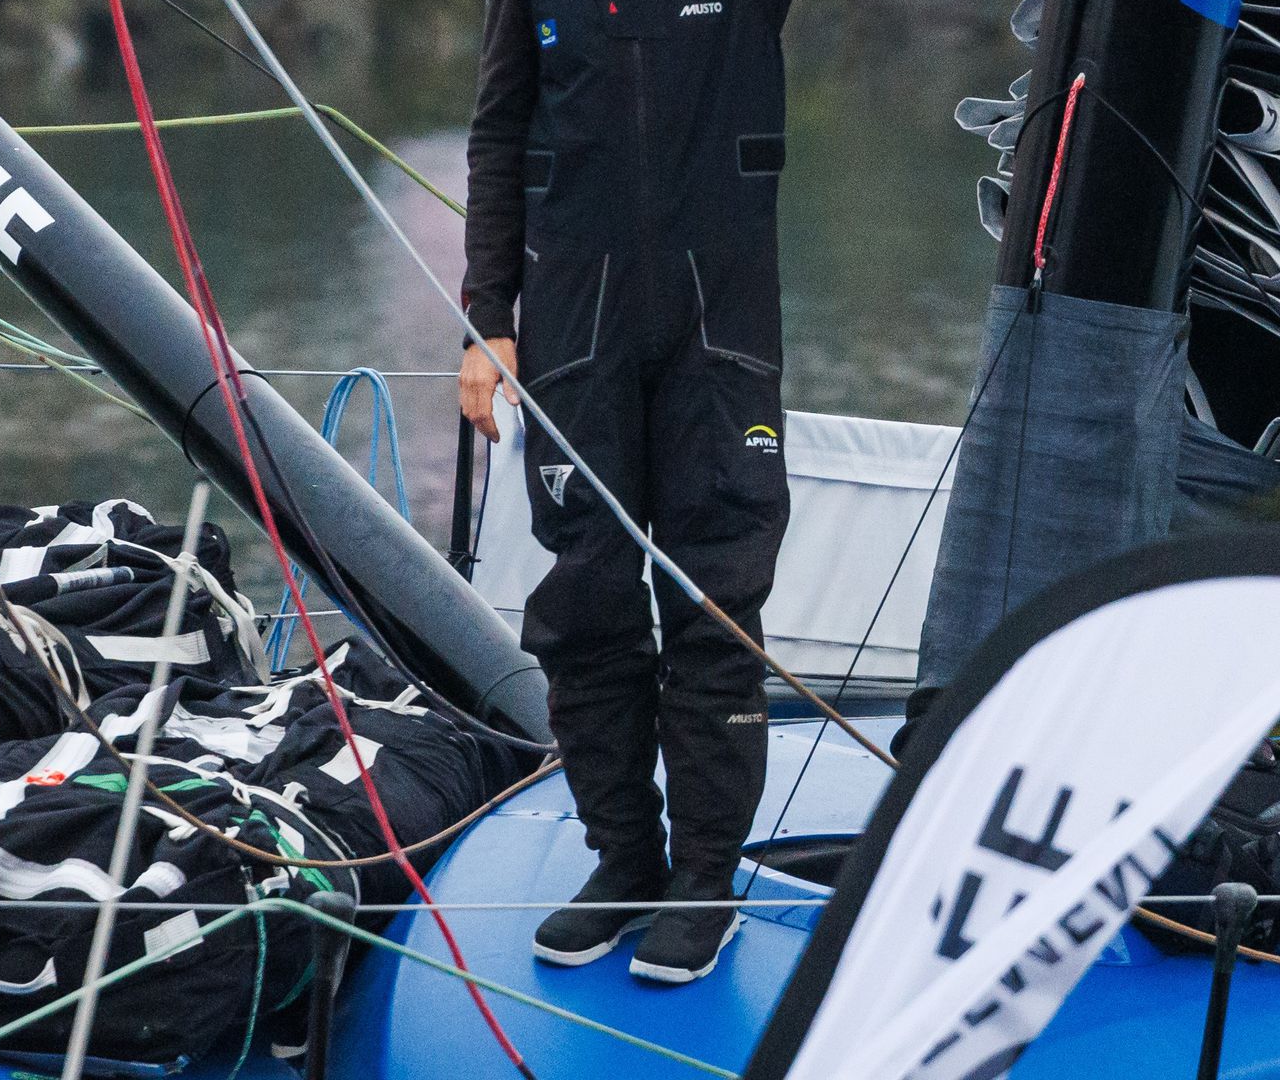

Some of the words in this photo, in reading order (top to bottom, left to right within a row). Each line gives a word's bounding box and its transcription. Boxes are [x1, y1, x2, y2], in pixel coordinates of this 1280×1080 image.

[680, 1, 723, 17] MUSTO
[745, 436, 778, 447] APIVIA
[727, 713, 762, 724] MUSTO
